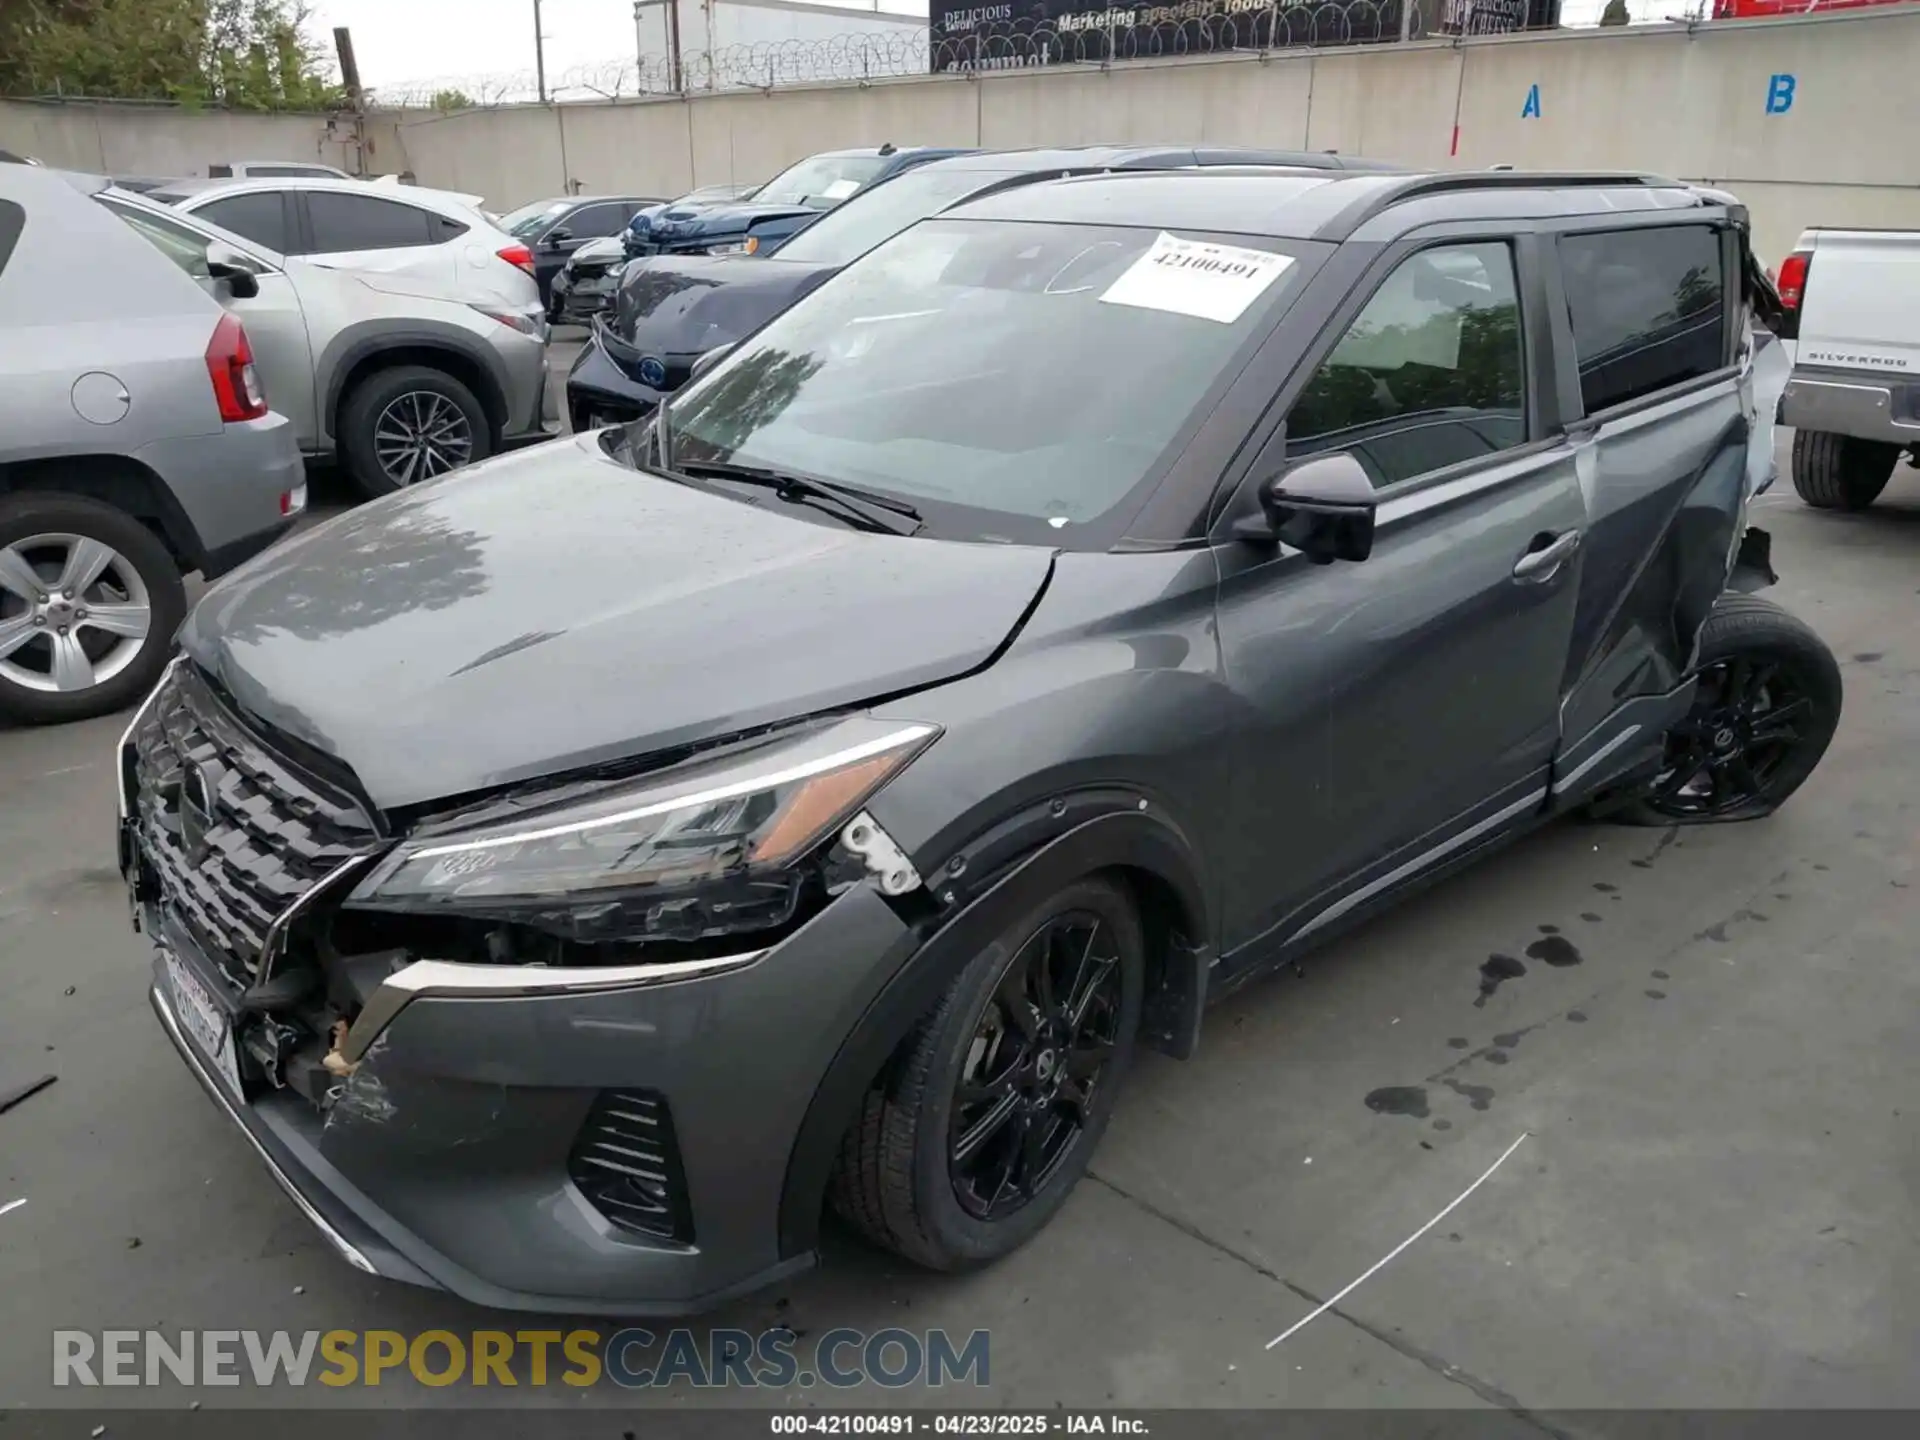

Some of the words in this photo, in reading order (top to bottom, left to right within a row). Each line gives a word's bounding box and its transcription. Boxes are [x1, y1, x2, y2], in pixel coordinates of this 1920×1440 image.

[944, 4, 1012, 22] DELICIOUS
[1058, 7, 1136, 30] Marketing
[1521, 84, 1541, 118] A
[1766, 74, 1796, 115] B
[1153, 252, 1259, 279] 42100491
